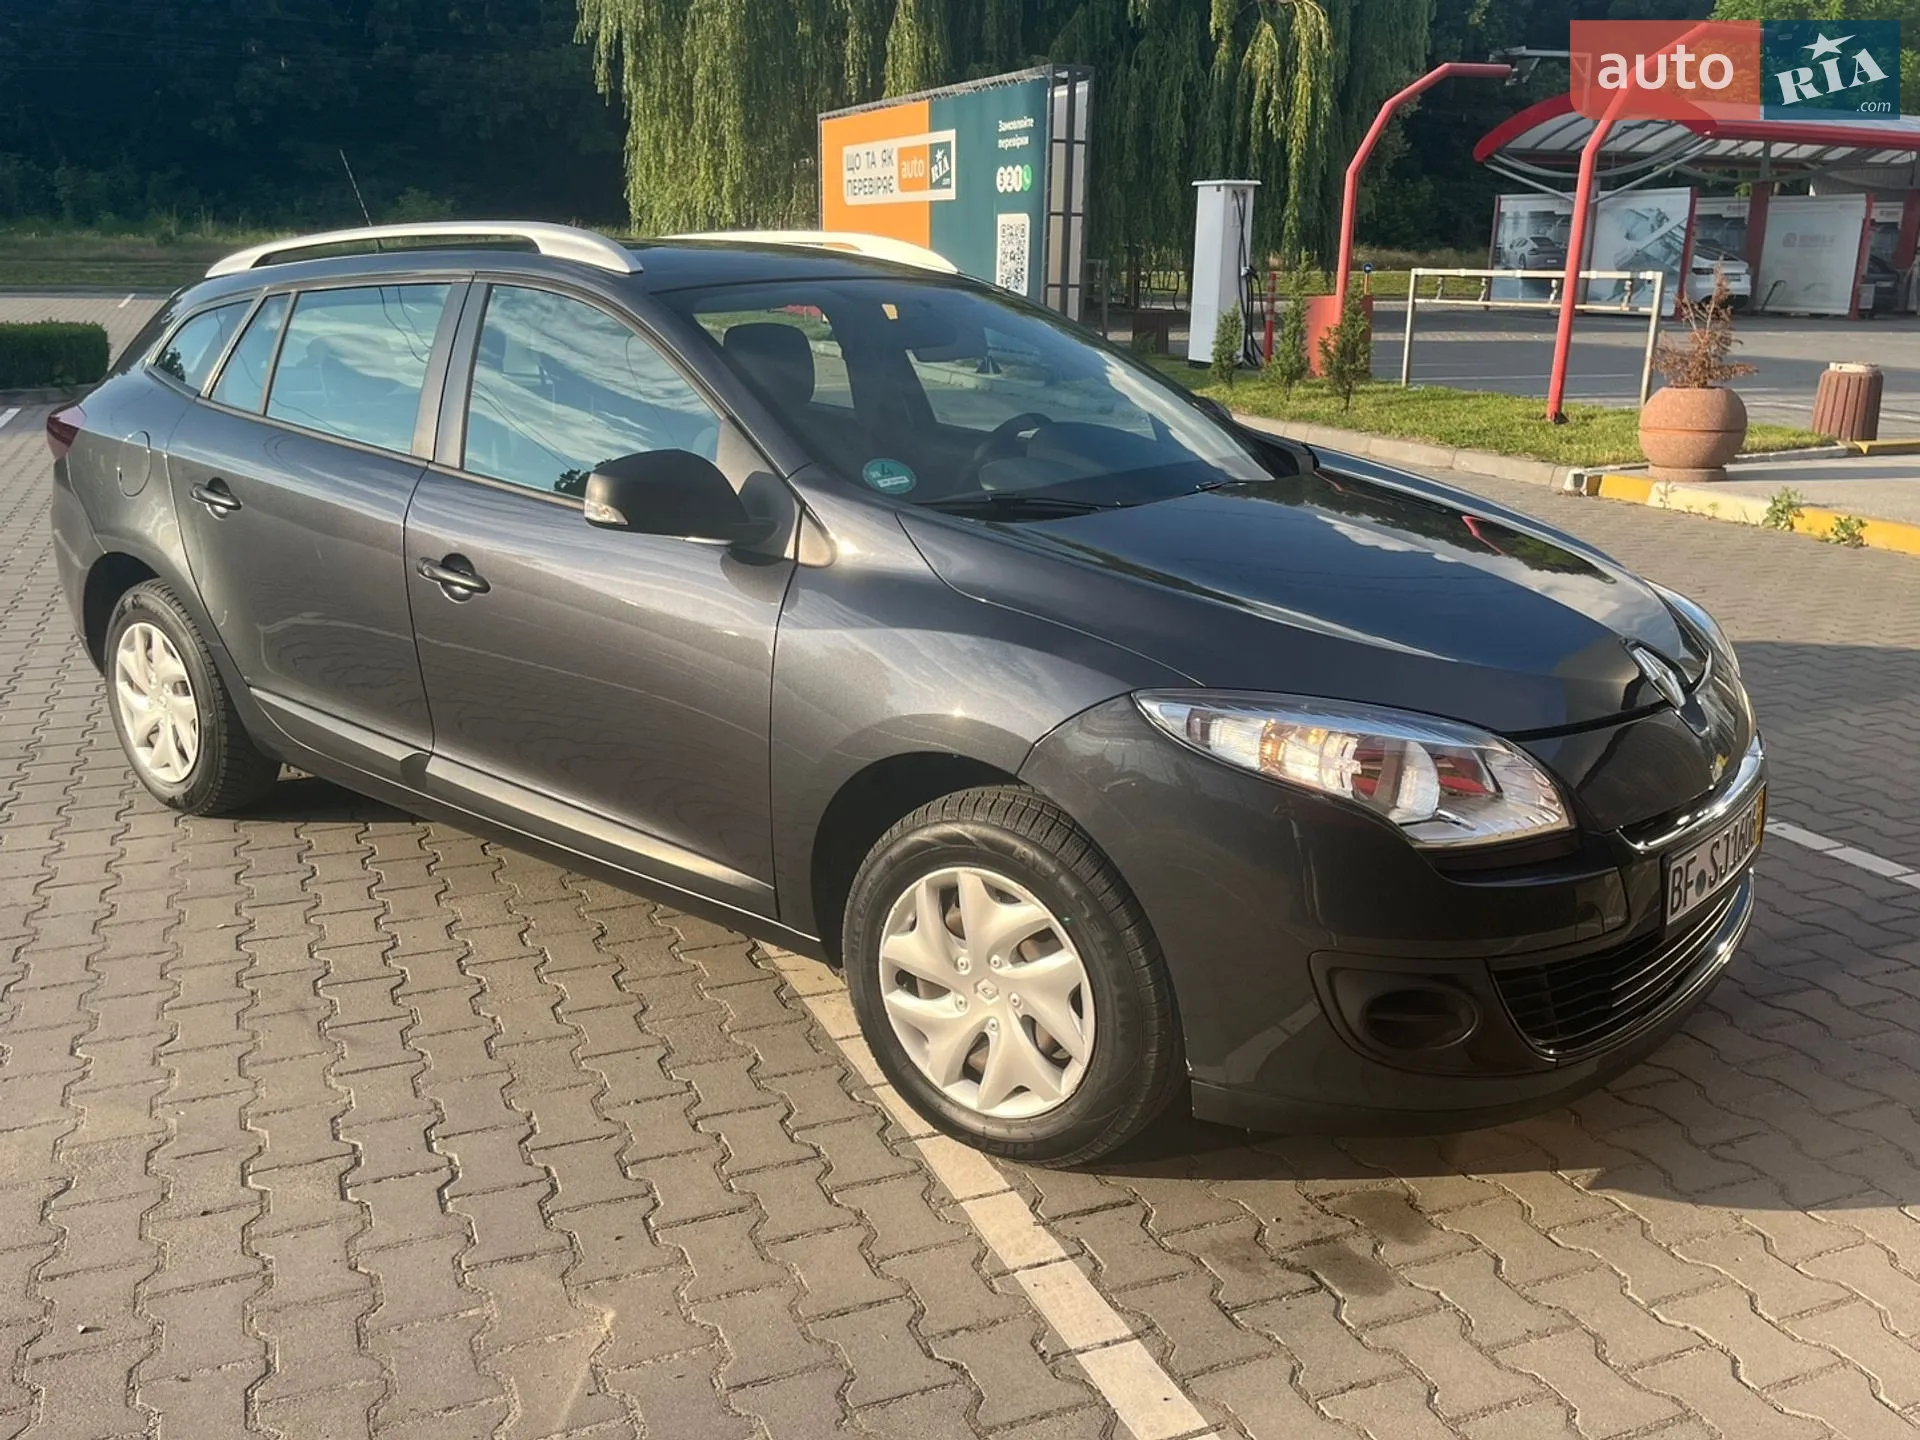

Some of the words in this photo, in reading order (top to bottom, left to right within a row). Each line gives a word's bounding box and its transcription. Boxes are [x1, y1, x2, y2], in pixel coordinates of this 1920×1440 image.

[846, 152, 862, 175] ЩО
[866, 151, 877, 169] ТА
[881, 147, 895, 168] ЯК
[901, 156, 925, 178] auto
[931, 155, 951, 184] RIA
[846, 175, 895, 197] ПЕРЕВІРЯЄ
[1670, 855, 1697, 916] BF
